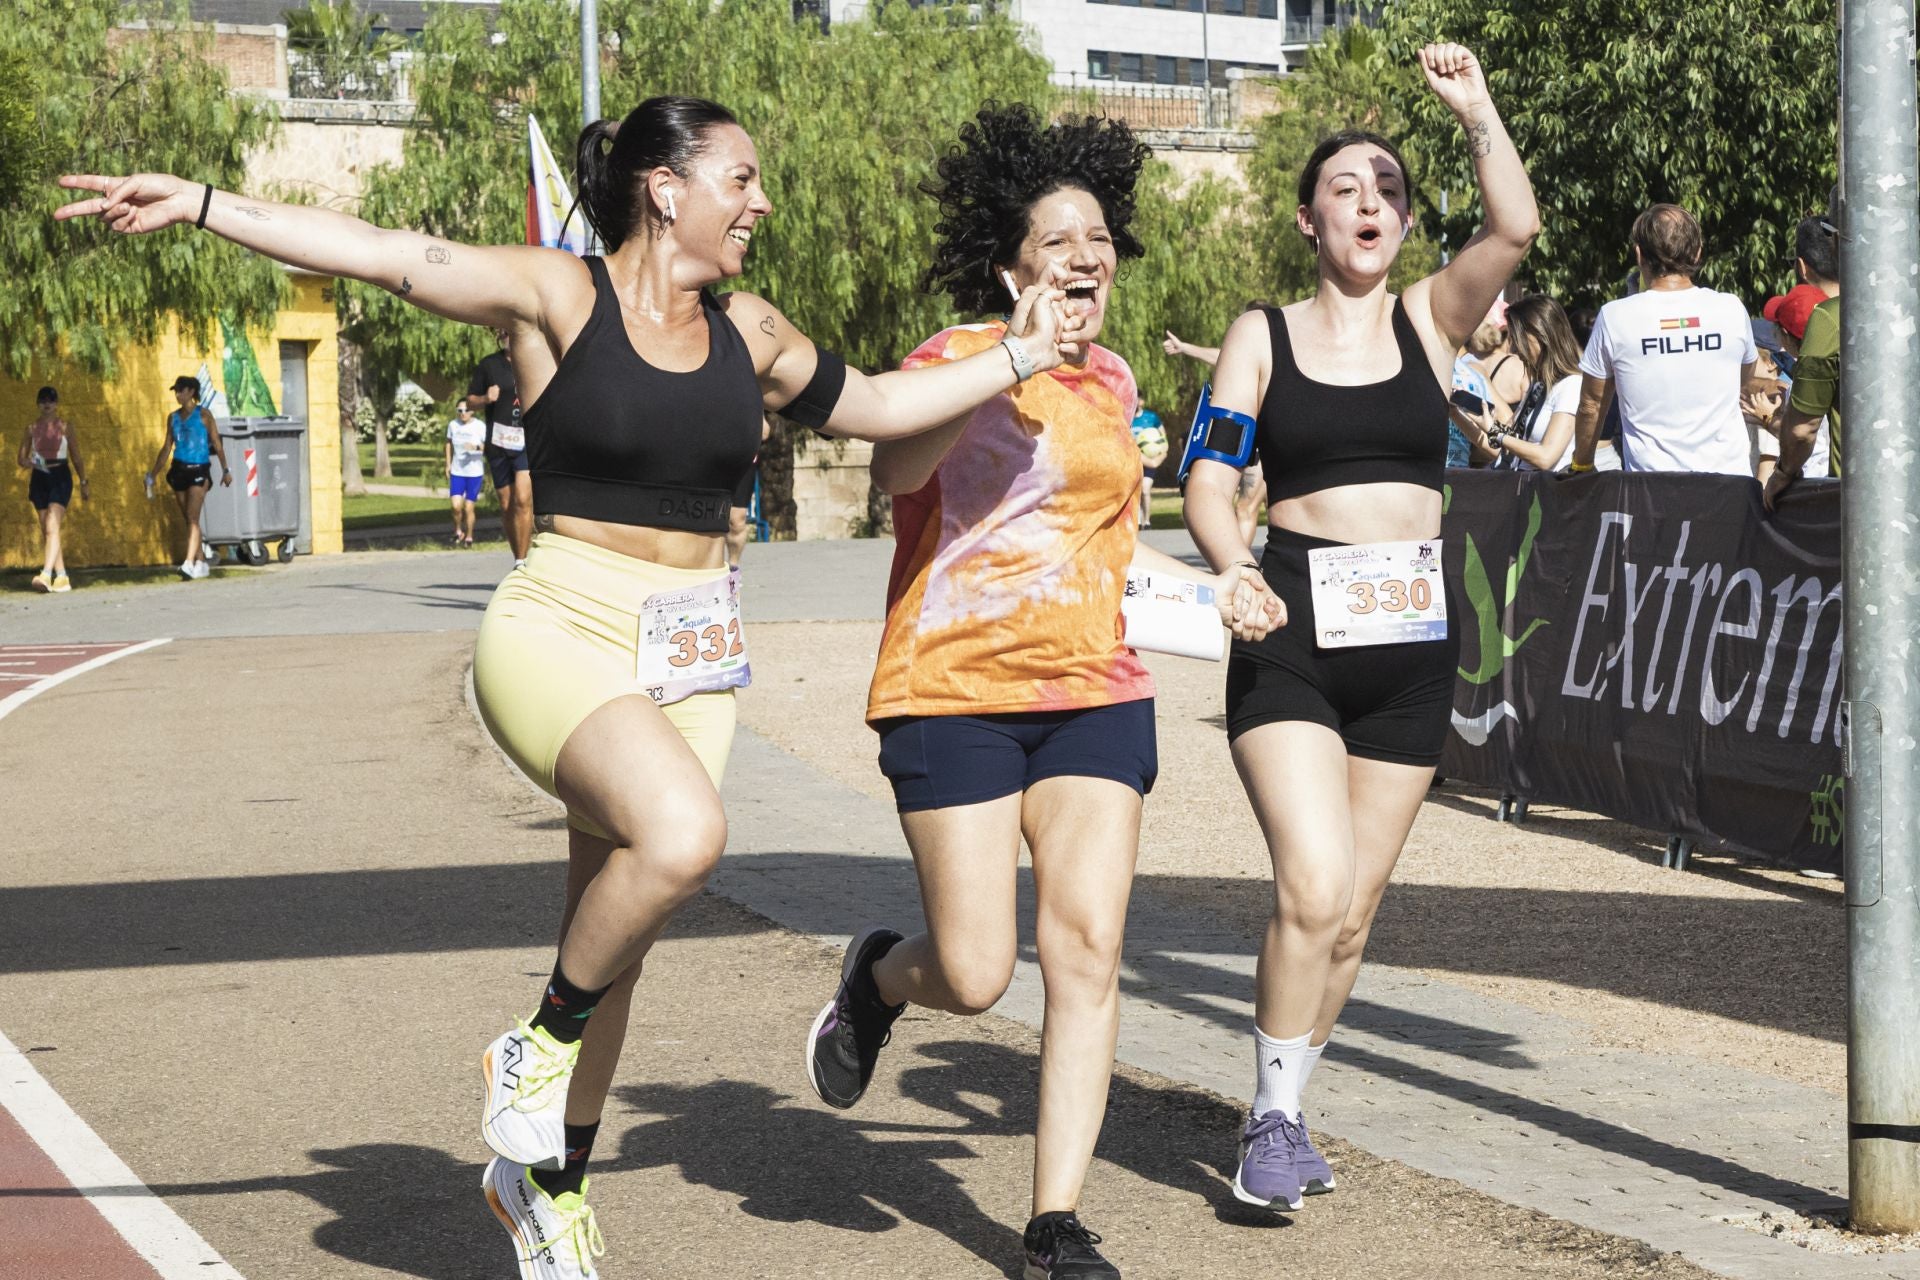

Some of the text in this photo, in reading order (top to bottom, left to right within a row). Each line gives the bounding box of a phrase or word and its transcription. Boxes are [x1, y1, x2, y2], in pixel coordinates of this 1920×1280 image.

[1641, 333, 1722, 355] FILHO
[652, 592, 695, 607] CARRERA
[1346, 578, 1431, 614] 330
[682, 615, 712, 629] aqualia
[1561, 511, 1843, 748] Extrem
[668, 617, 744, 668] 332
[516, 1179, 531, 1206] new
